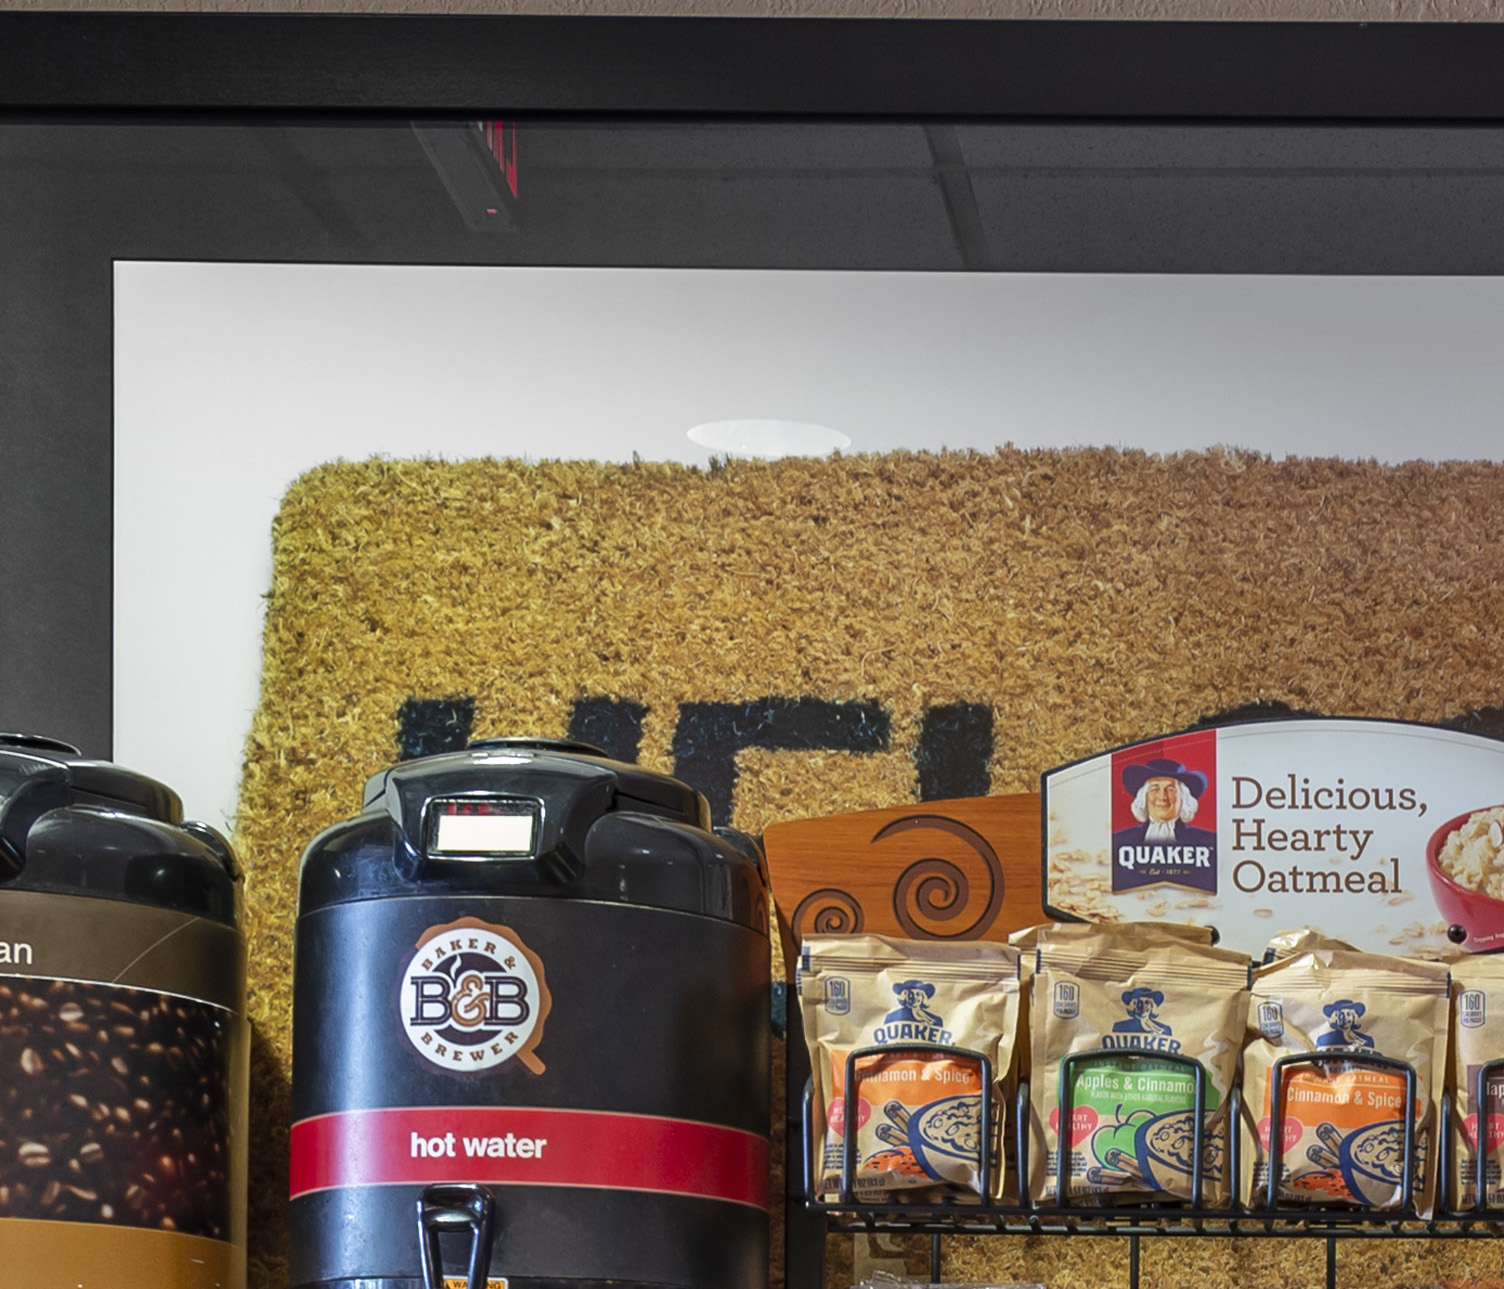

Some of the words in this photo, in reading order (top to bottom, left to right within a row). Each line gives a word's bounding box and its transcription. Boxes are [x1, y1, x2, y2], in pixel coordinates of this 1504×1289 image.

[1231, 774, 1428, 817] Delicious,
[1231, 818, 1374, 860] Hearty
[1118, 845, 1211, 870] QUAKER
[1232, 858, 1403, 894] Oatmeal
[422, 939, 496, 971] BAKER
[504, 955, 517, 971] &
[410, 974, 530, 1028] B&B
[1465, 994, 1480, 1010] 160
[421, 1030, 519, 1062] BREWER
[873, 1023, 952, 1046] QUAKER
[1077, 1074, 1119, 1090] Apples
[1124, 1077, 1132, 1090] &
[1137, 1077, 1195, 1093] Cinnamo
[1286, 1087, 1350, 1104] Cinnamon
[1354, 1094, 1363, 1105] &
[1367, 1093, 1402, 1109] Spice
[410, 1132, 456, 1158] hot
[463, 1135, 547, 1159] water
